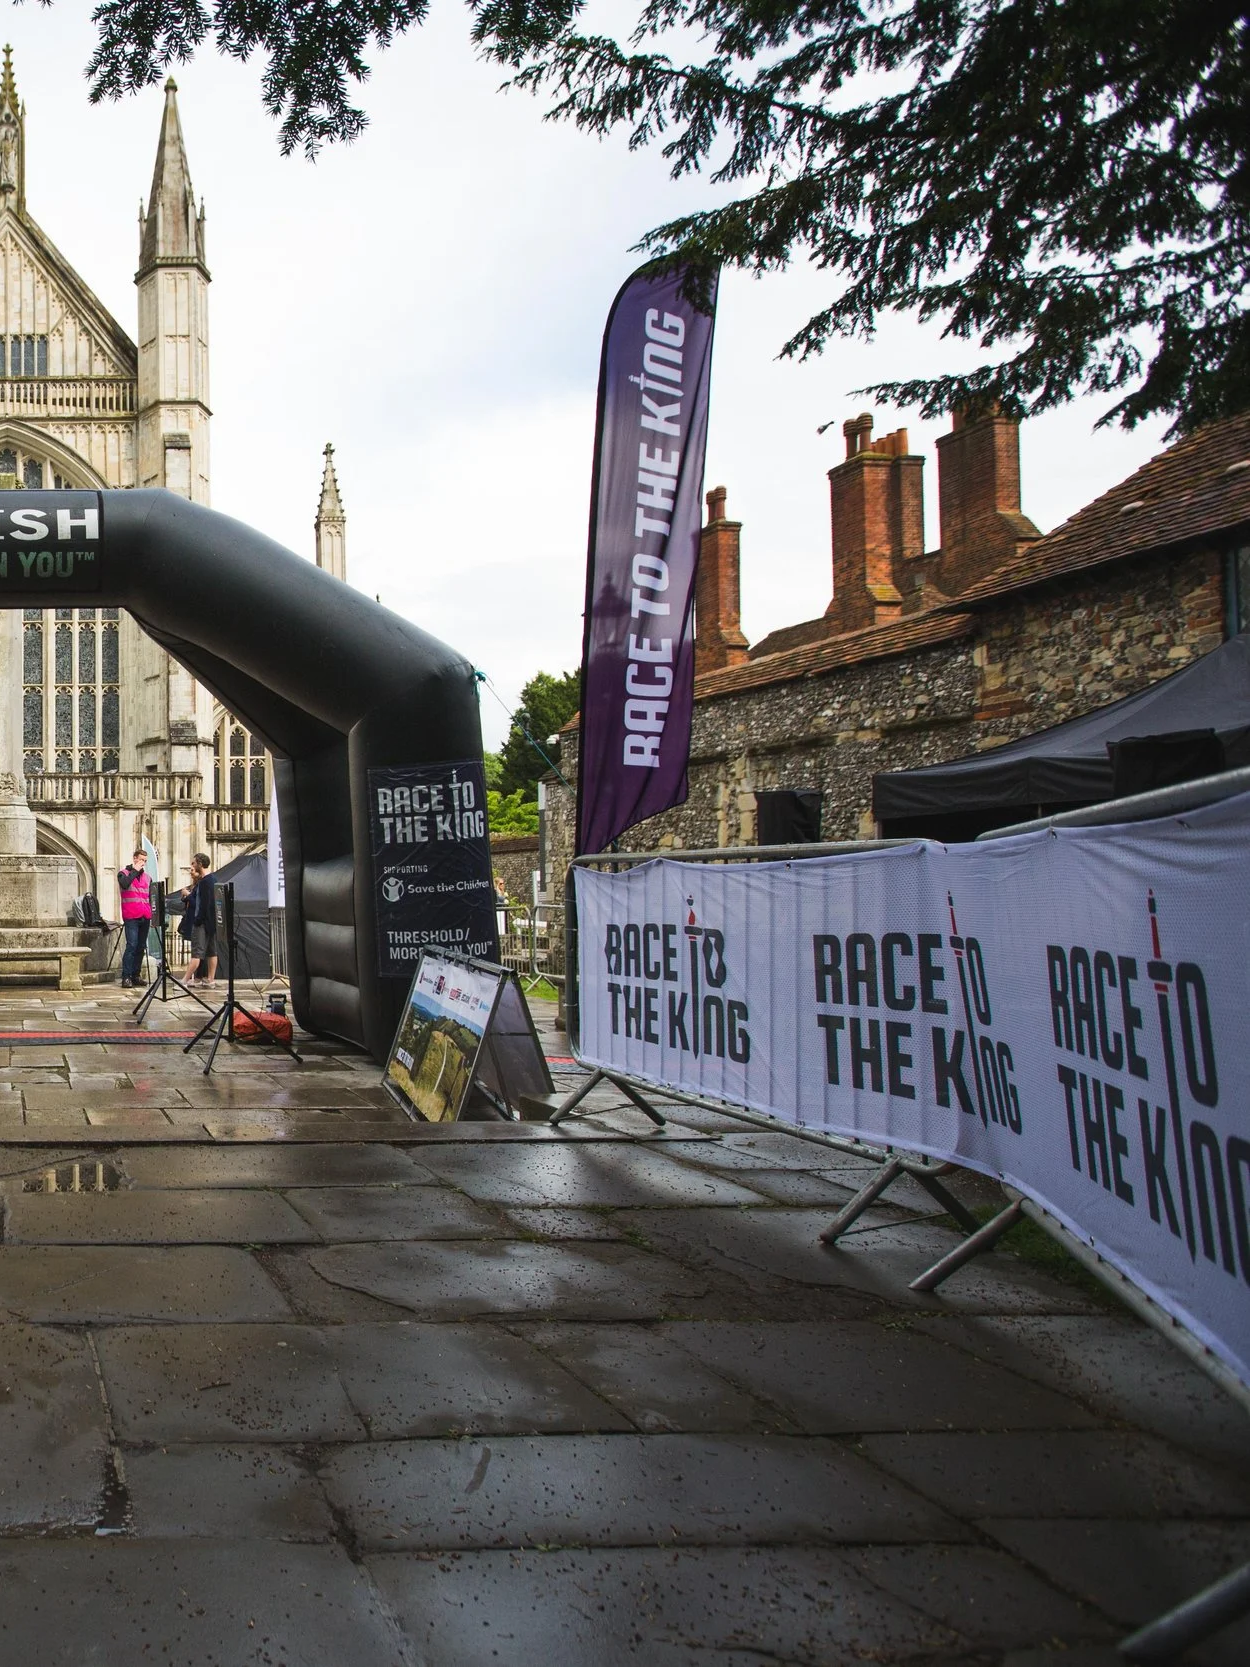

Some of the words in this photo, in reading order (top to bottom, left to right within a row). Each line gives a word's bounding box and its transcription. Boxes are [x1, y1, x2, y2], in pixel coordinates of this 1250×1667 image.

[629, 308, 686, 437] KING
[634, 443, 680, 540] THE
[631, 553, 671, 625] TO
[622, 633, 674, 769] RACE
[377, 784, 444, 815] RACE
[449, 780, 475, 809] TO
[380, 815, 429, 844] THE
[436, 810, 485, 842] KING
[383, 864, 428, 874] SUPPORTING
[407, 883, 435, 894] Save
[437, 882, 455, 893] the
[456, 879, 490, 891] Children
[605, 922, 678, 979] RACE
[684, 922, 726, 988] TO
[812, 931, 949, 1016] RACE
[949, 934, 992, 1026] TO
[607, 982, 659, 1045] THE
[668, 991, 751, 1063] KING
[1046, 944, 1149, 1081] RACE
[1147, 960, 1219, 1109] TO
[817, 1013, 917, 1100] THE
[932, 1025, 1023, 1136] KING
[1057, 1063, 1135, 1208] THE
